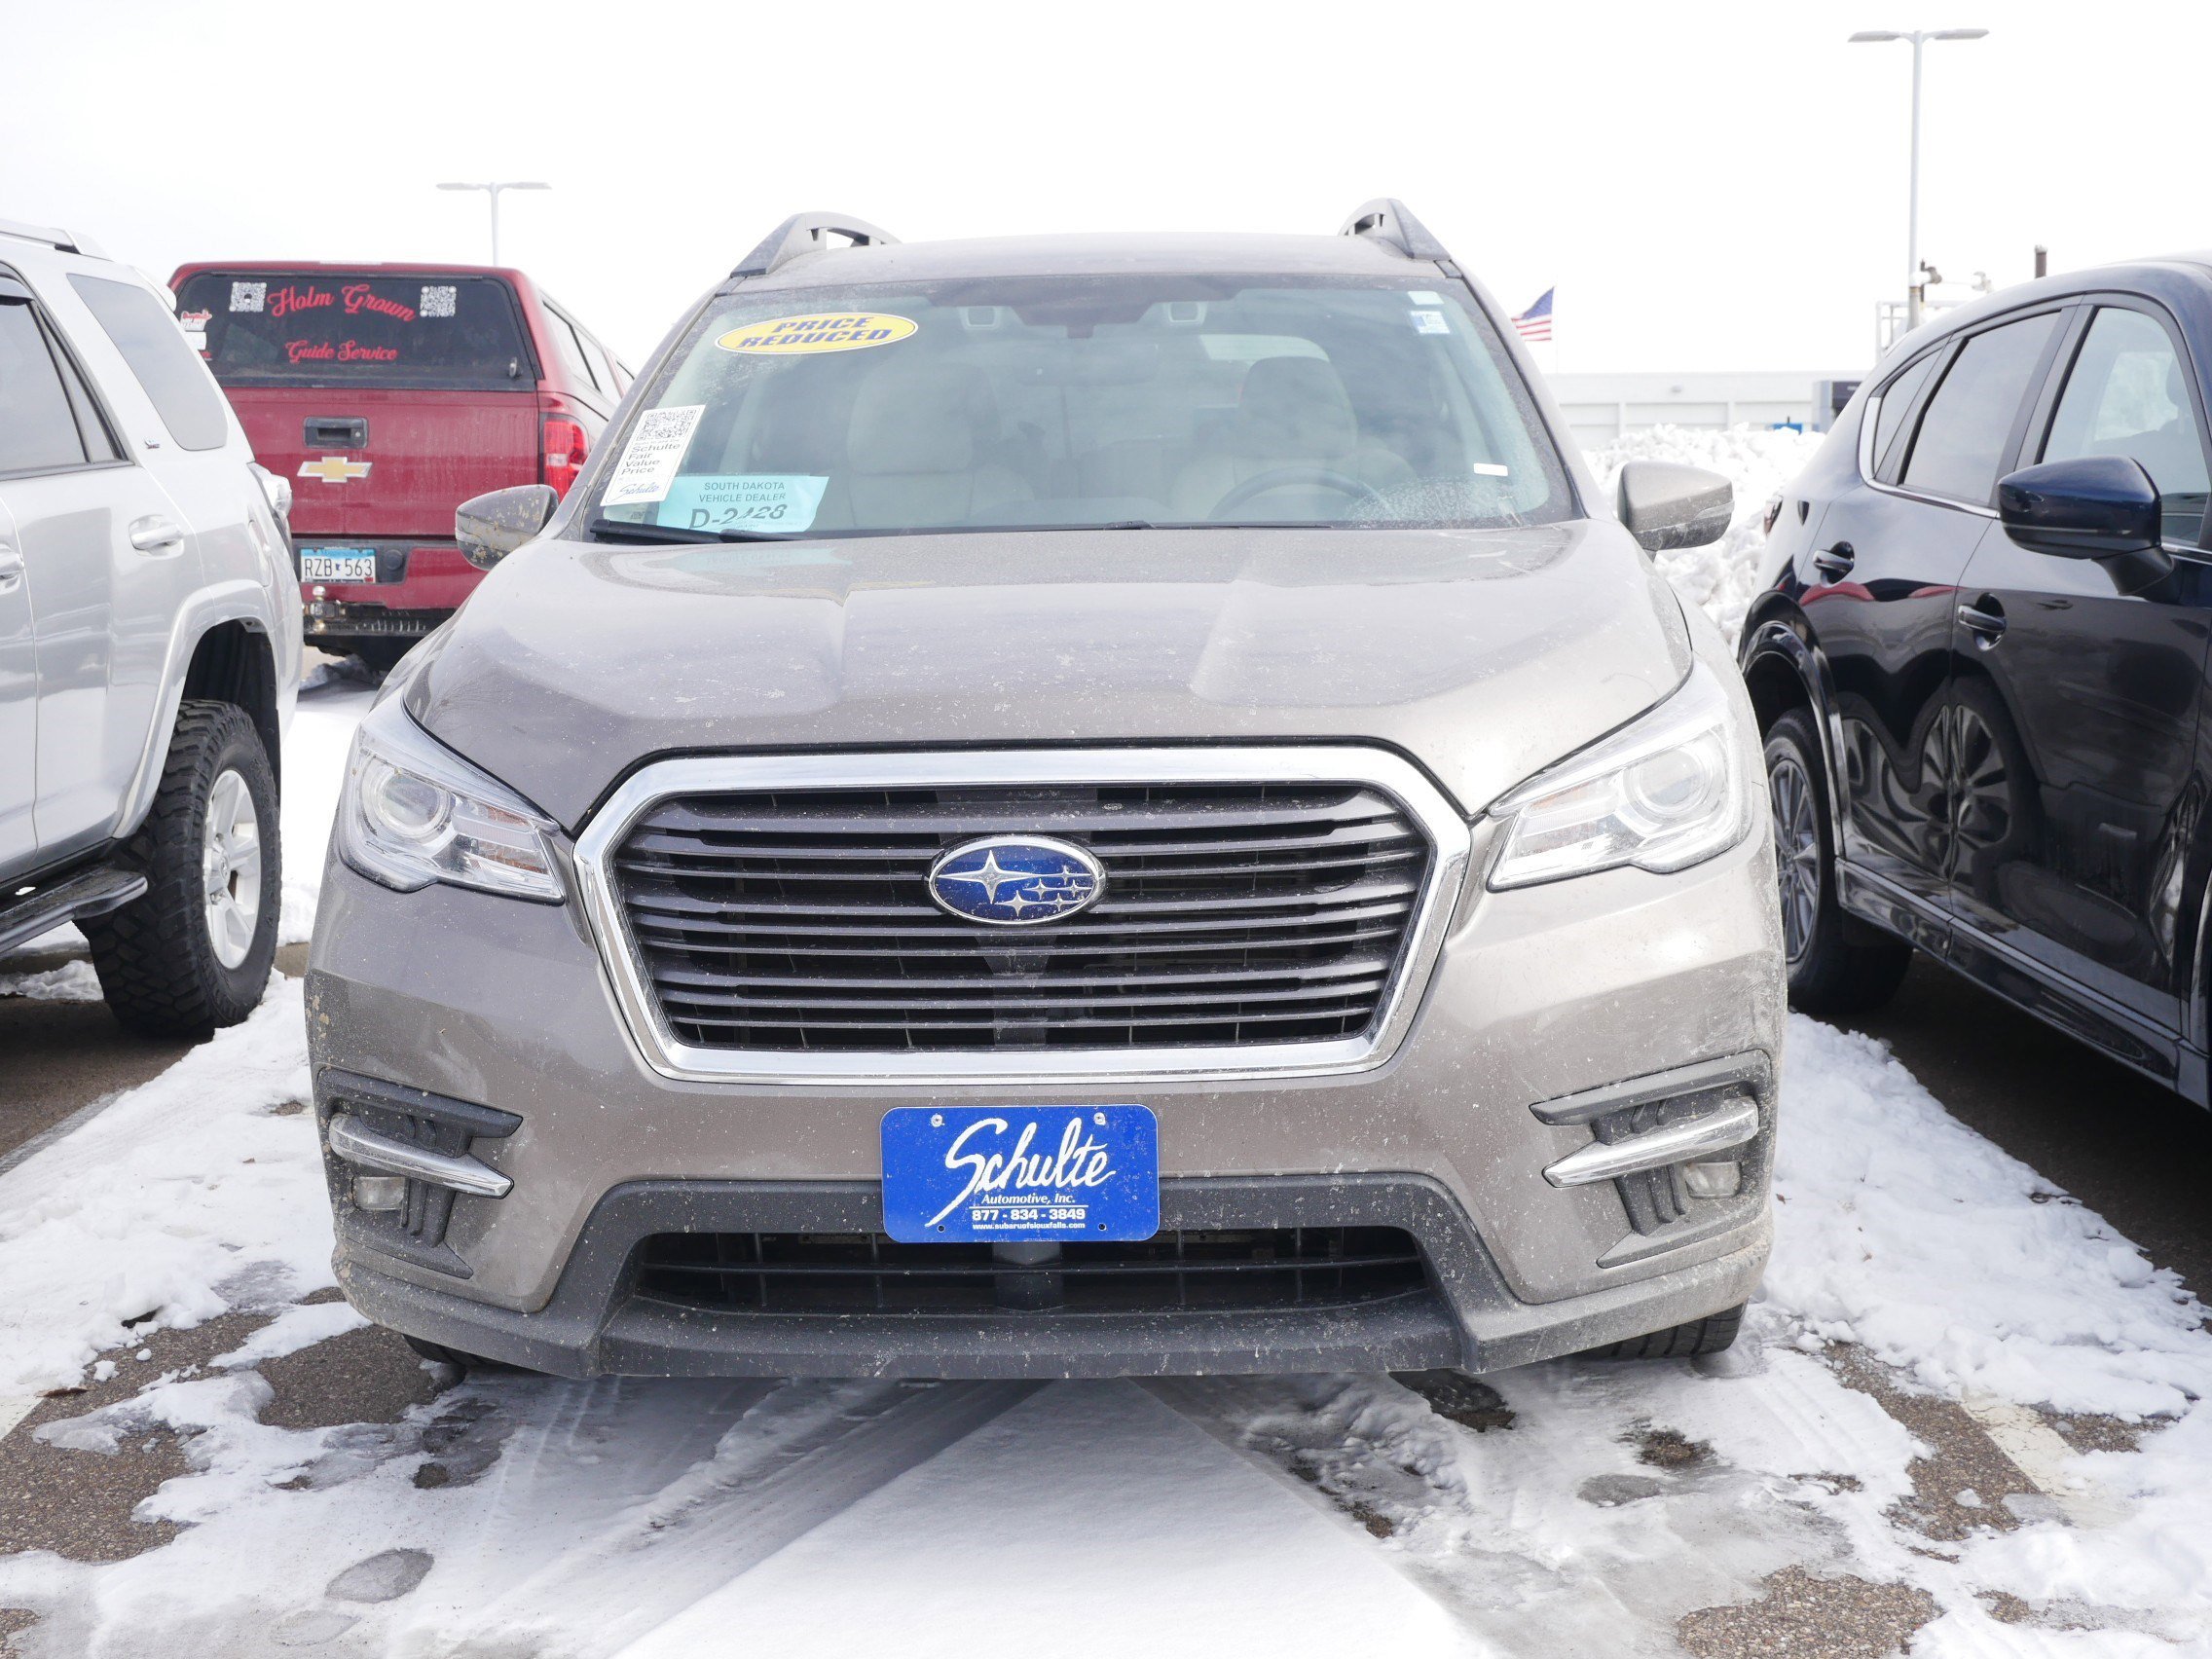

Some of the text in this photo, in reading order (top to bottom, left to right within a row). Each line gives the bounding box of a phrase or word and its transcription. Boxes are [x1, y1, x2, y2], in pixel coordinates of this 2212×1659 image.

[267, 284, 416, 322] Holm Grown
[772, 316, 874, 333] PRICE
[736, 329, 893, 349] REDUCED
[285, 340, 398, 364] Guide Service
[631, 442, 681, 453] Schulte
[628, 452, 653, 461] Fair
[621, 466, 655, 475] Price
[704, 481, 786, 491] SOUTH DAKOTA
[699, 492, 787, 502] VEHICLE DEALER
[305, 558, 373, 577] RZB 563
[925, 1117, 1117, 1228] Schulte
[980, 1192, 1076, 1205] Automotive, Inc.
[972, 1221, 1086, 1230] www.subaruofsiouxfalls.com
